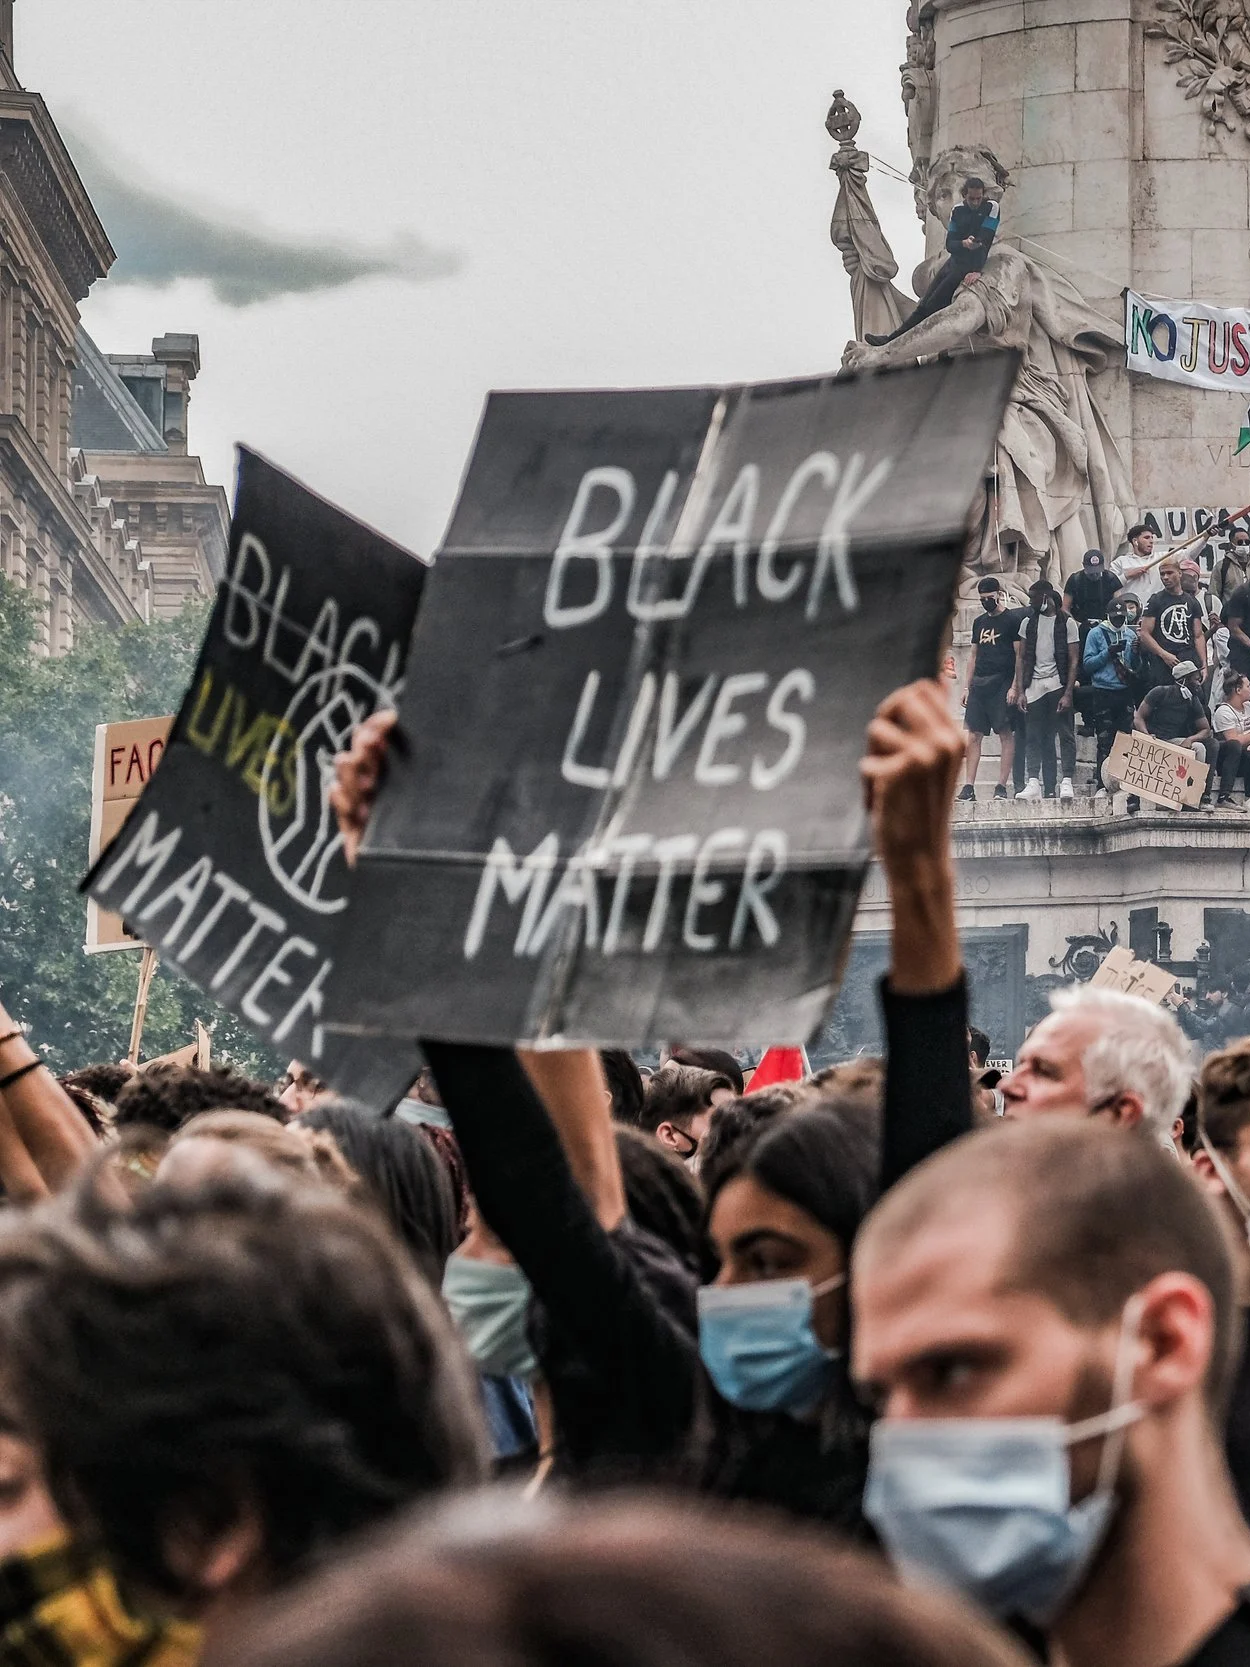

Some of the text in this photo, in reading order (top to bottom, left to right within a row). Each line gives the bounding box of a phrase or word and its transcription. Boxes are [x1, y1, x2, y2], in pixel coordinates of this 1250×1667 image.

[1130, 304, 1176, 362] NO
[543, 450, 895, 629] BLACK
[186, 667, 301, 817] LIVES
[562, 668, 815, 791] LIVES
[1127, 738, 1172, 768] BLACK
[1128, 753, 1174, 784] LIVES
[1124, 768, 1182, 803] MATTER
[464, 827, 788, 961] MATTER
